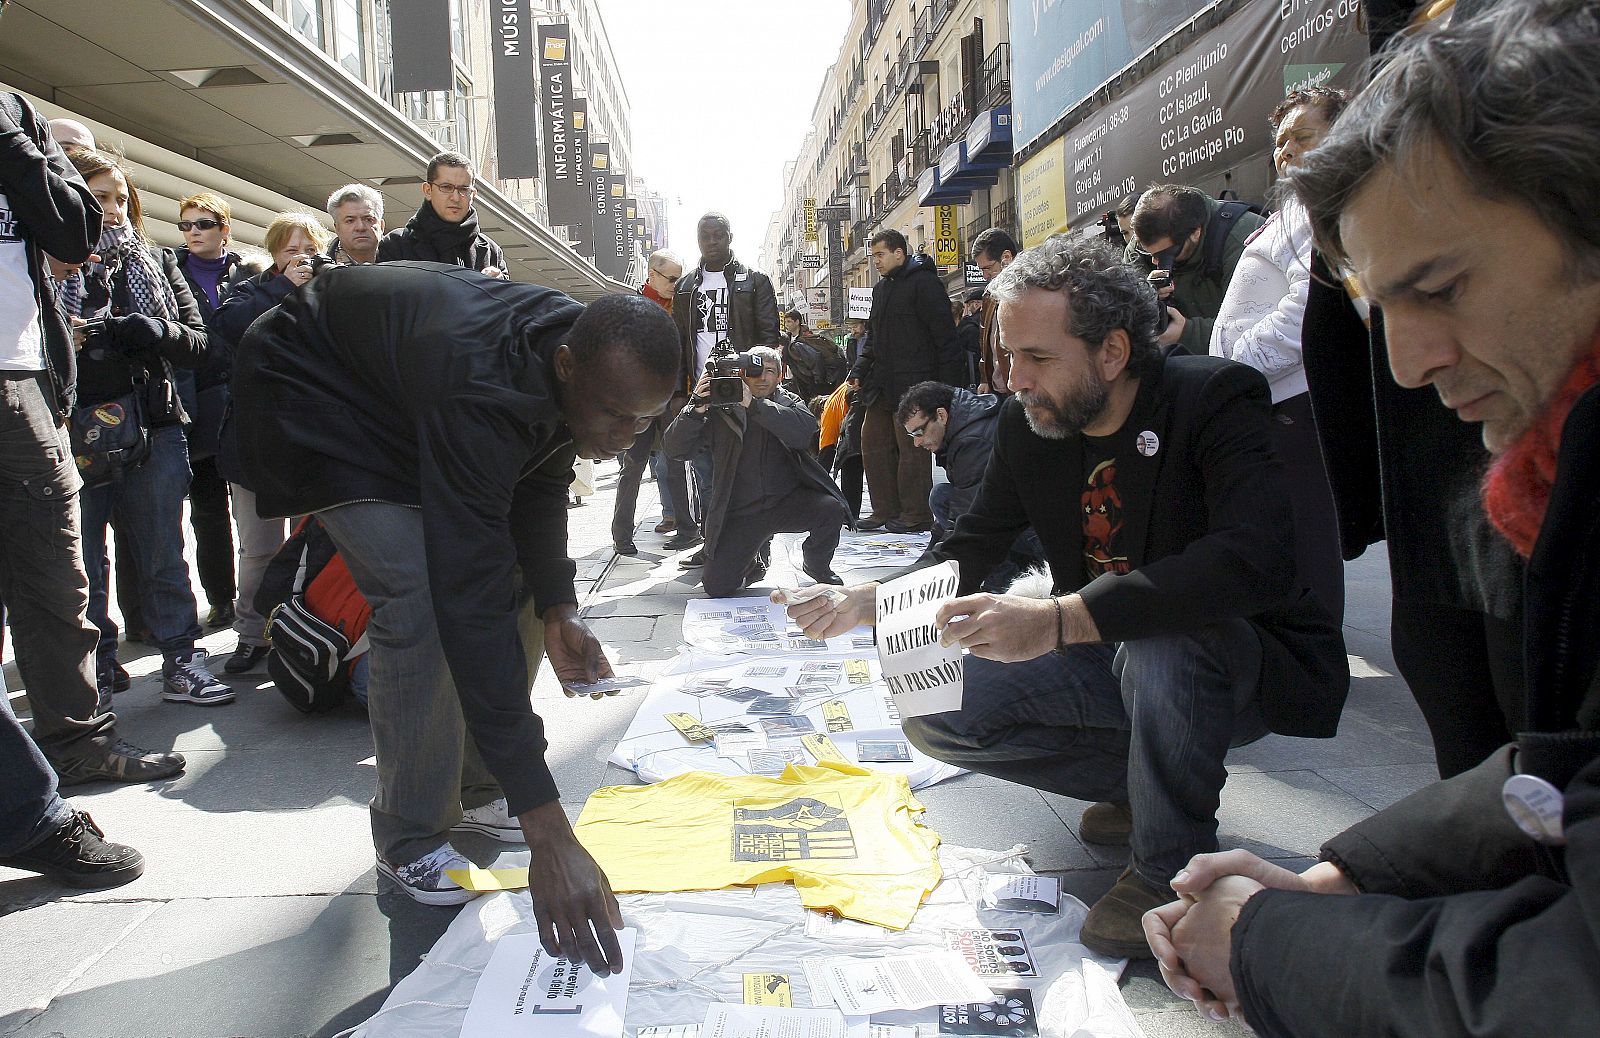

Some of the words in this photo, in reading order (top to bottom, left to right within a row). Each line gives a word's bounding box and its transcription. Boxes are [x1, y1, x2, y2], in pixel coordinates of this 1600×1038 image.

[1281, 8, 1333, 53] centros
[1035, 16, 1105, 92] www.desigual.com
[1159, 76, 1173, 98] CC
[1175, 43, 1228, 88] Plenilunio
[1159, 102, 1174, 124] CC
[1175, 81, 1211, 115] Islazul,
[549, 73, 568, 180] INFORMÁTICA
[1074, 118, 1108, 152] Fuencarral
[1109, 106, 1129, 130] 36-38
[1160, 129, 1175, 150] CC
[1177, 125, 1190, 143] La
[1191, 106, 1222, 134] Gavia
[1074, 153, 1094, 174] Mayor
[1095, 146, 1102, 162] 11
[1162, 156, 1177, 176] CC
[1178, 138, 1223, 170] Principe
[1224, 126, 1244, 149] Pio
[596, 176, 606, 215] SONIDO
[1075, 177, 1092, 195] Goya
[1093, 170, 1101, 186] 64
[1077, 197, 1095, 215] Bravo
[1096, 184, 1120, 206] Murillo
[1122, 176, 1135, 194] 106
[612, 203, 624, 257] FOTOGRAFÍA
[940, 204, 952, 237] OMPRO
[937, 238, 957, 252] ORO
[879, 595, 895, 623] ¡NI
[899, 588, 915, 612] UN
[918, 575, 956, 605] SÓLO
[886, 622, 938, 656] MANTERO
[887, 673, 905, 695] EN
[903, 658, 963, 693] PRISIÓN
[951, 932, 961, 951] PERS
[959, 930, 981, 974] SOMOS
[972, 930, 989, 974] CRIMINALES
[981, 930, 991, 943] NO
[553, 967, 564, 978] es
[984, 944, 1000, 974] SOMOS
[547, 979, 564, 999] delito
[514, 1006, 524, 1015] YA
